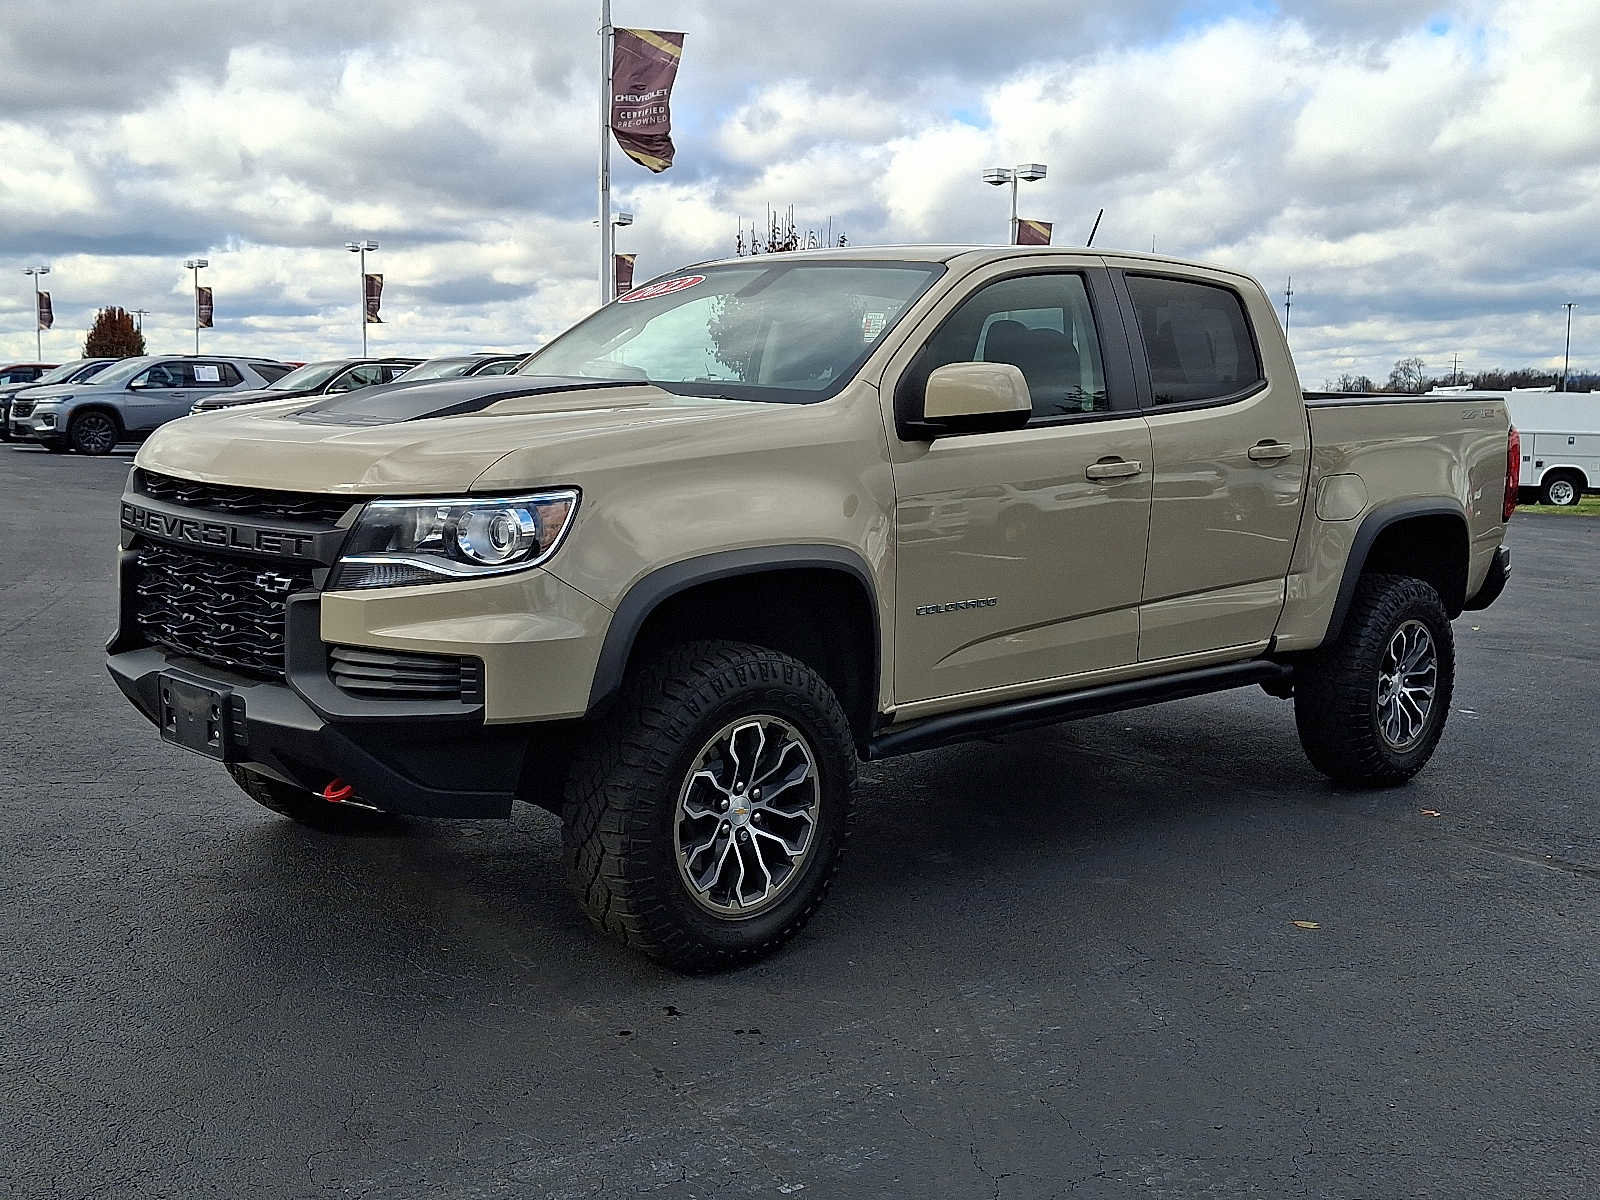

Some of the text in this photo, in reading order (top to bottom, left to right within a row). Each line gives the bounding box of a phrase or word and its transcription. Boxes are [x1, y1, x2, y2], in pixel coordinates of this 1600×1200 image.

[615, 88, 668, 102] CHEVROLET
[620, 106, 665, 119] CERTIFIED
[617, 115, 667, 128] PRE-OWNED
[121, 503, 314, 556] CHEVROLET
[915, 596, 998, 615] COLORADO
